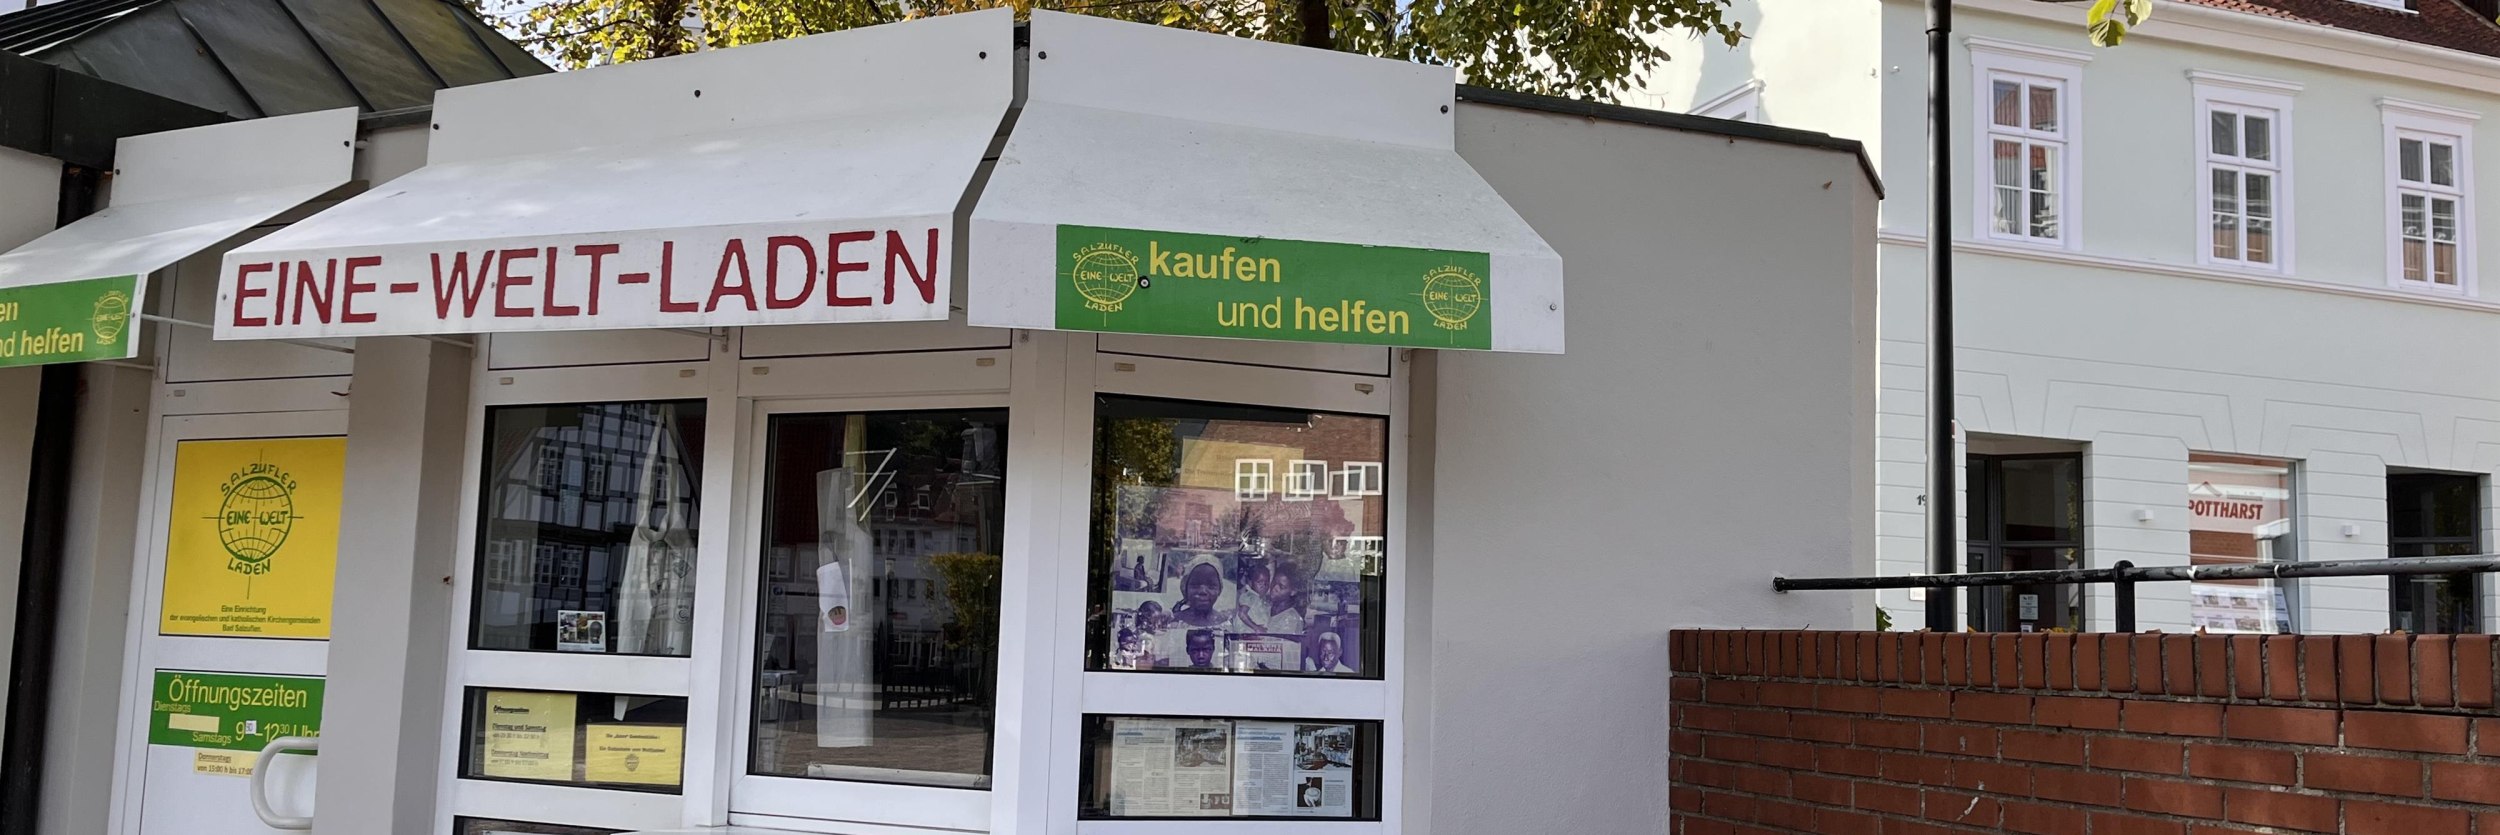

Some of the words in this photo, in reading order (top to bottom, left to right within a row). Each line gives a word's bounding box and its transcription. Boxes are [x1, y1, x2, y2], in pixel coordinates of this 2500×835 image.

[1072, 242, 1139, 265] SALZUFLER
[1149, 241, 1281, 283] kaufen
[233, 228, 937, 327] EINE-WELT-LADEN
[1080, 270, 1102, 281] EINE
[1109, 273, 1134, 283] WELT
[1422, 264, 1482, 287] SALZUFLER
[1429, 291, 1449, 301] EINE
[1085, 300, 1123, 312] LADEN
[1218, 297, 1281, 329] und
[1295, 298, 1409, 335] helfen
[1433, 319, 1467, 330] LADEN
[20, 328, 84, 356] helfen
[221, 463, 297, 496] SALZUFLER
[226, 510, 251, 525] EINE
[260, 510, 288, 525] WELT
[227, 557, 271, 575] LADEN
[234, 605, 267, 615] Einrichtung
[168, 674, 307, 712] Öffnungszeiten
[154, 701, 191, 713] Dienstags
[192, 731, 232, 746] Samstags
